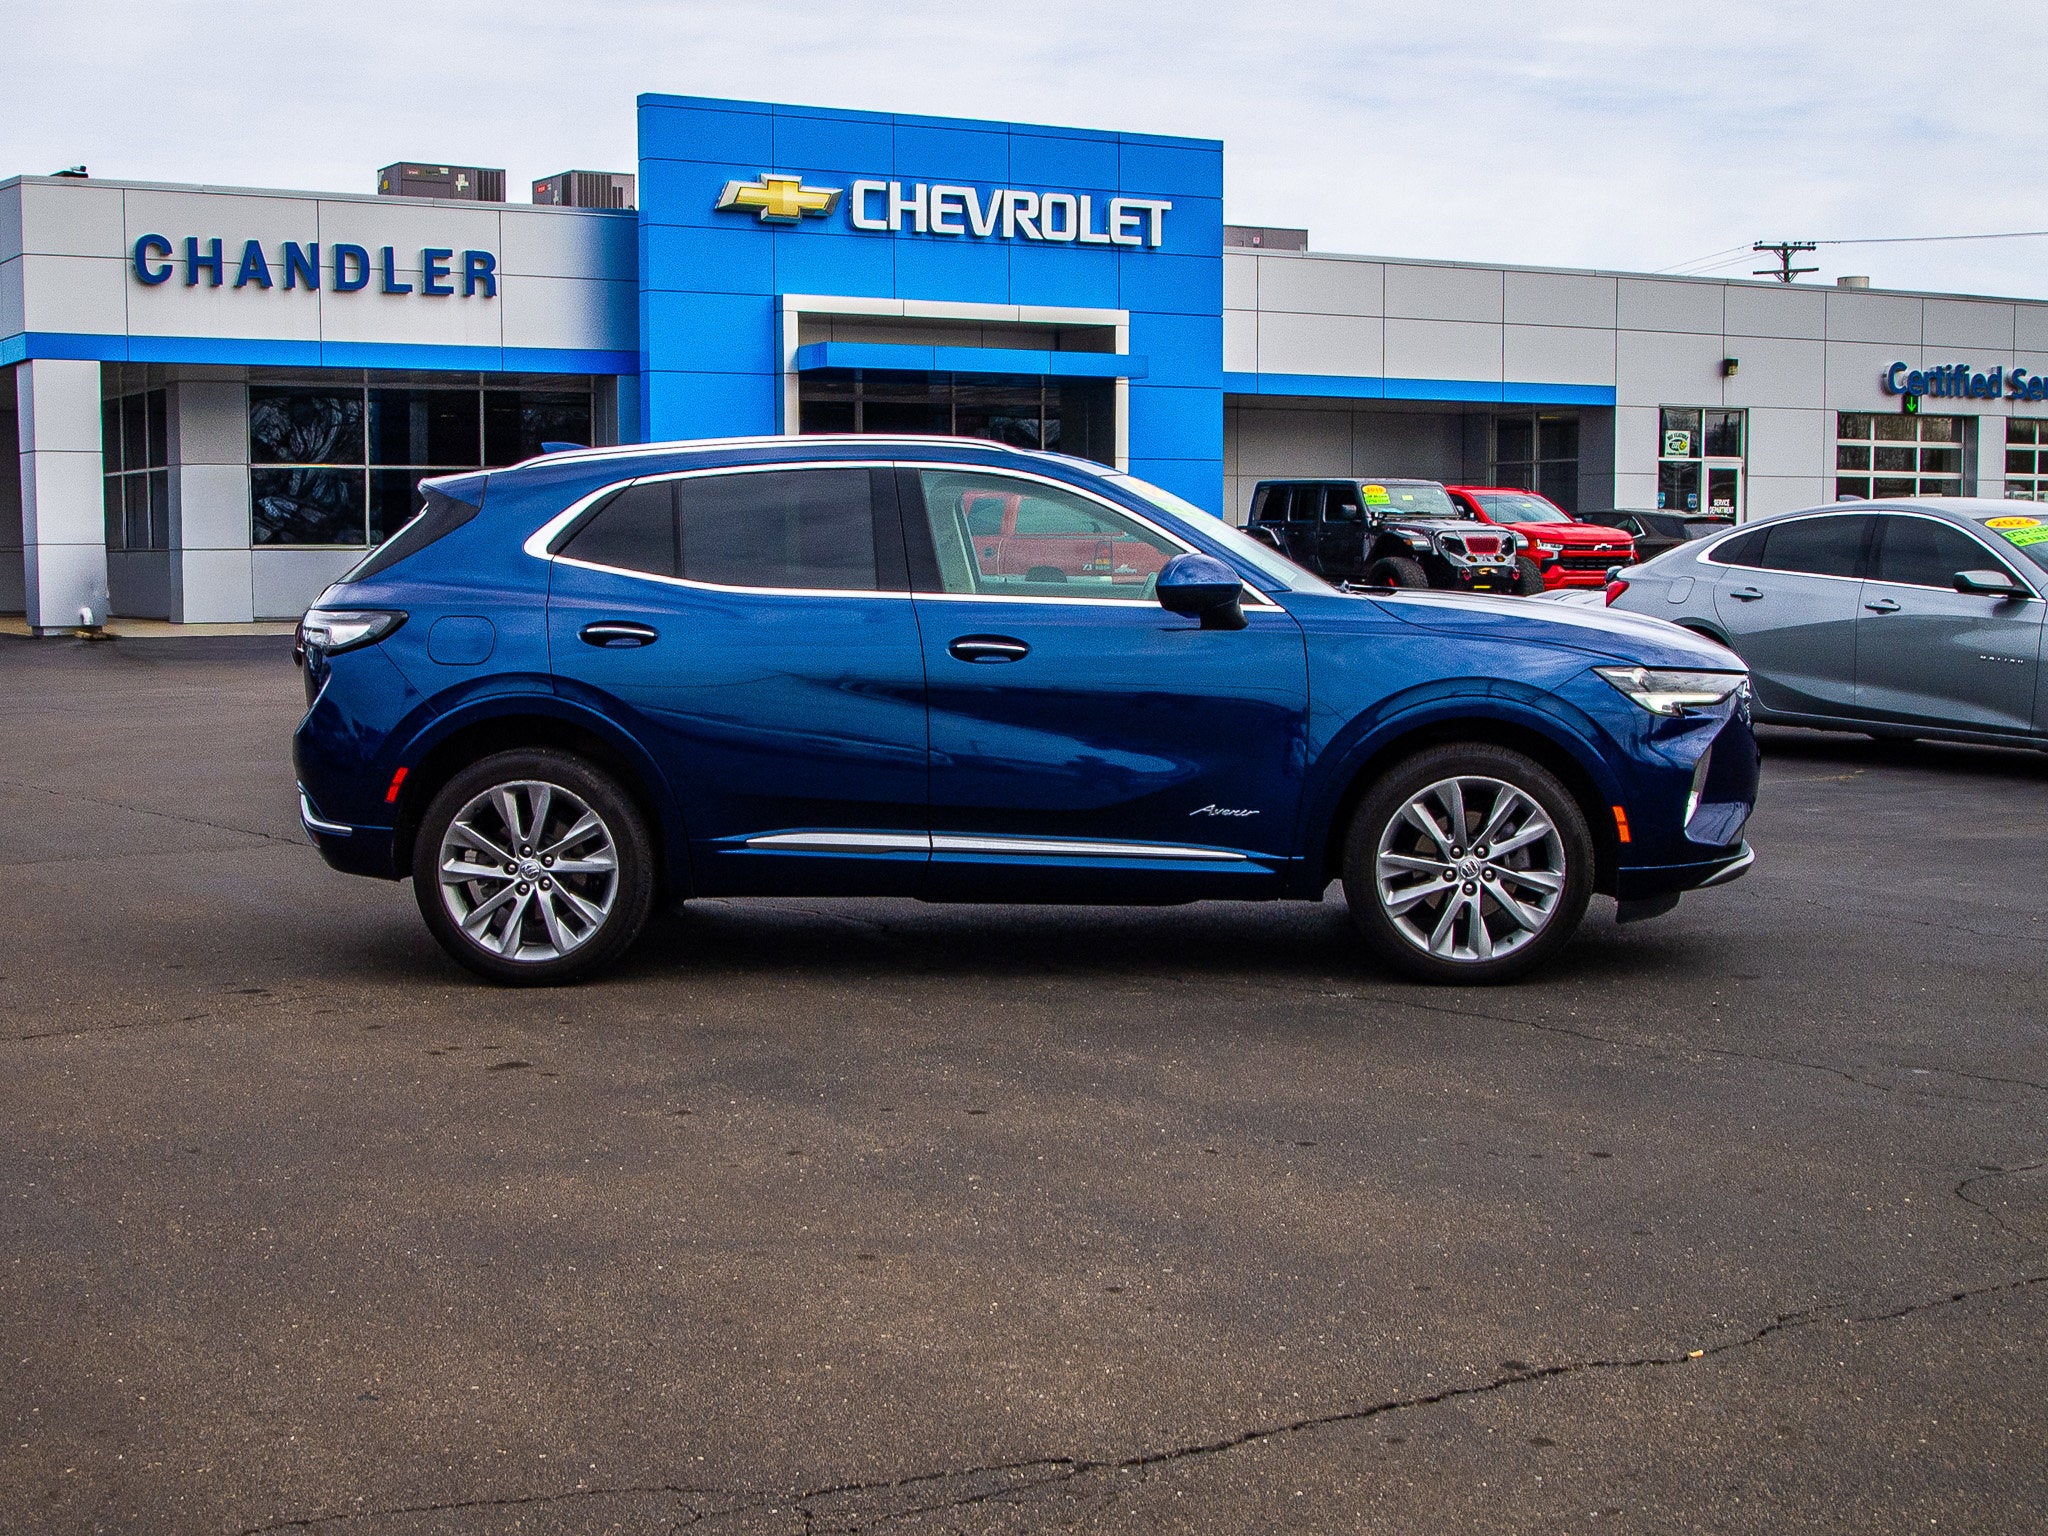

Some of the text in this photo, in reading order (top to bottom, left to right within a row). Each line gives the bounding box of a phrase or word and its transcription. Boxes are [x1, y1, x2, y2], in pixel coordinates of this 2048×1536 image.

[852, 179, 1172, 247] CHEVROLET
[134, 233, 498, 298] CHANDLER
[1886, 361, 2003, 398] Certified
[1709, 506, 1735, 514] DEPARTMENT
[1713, 498, 1730, 507] SERVICE
[1189, 804, 1260, 817] Avenir
